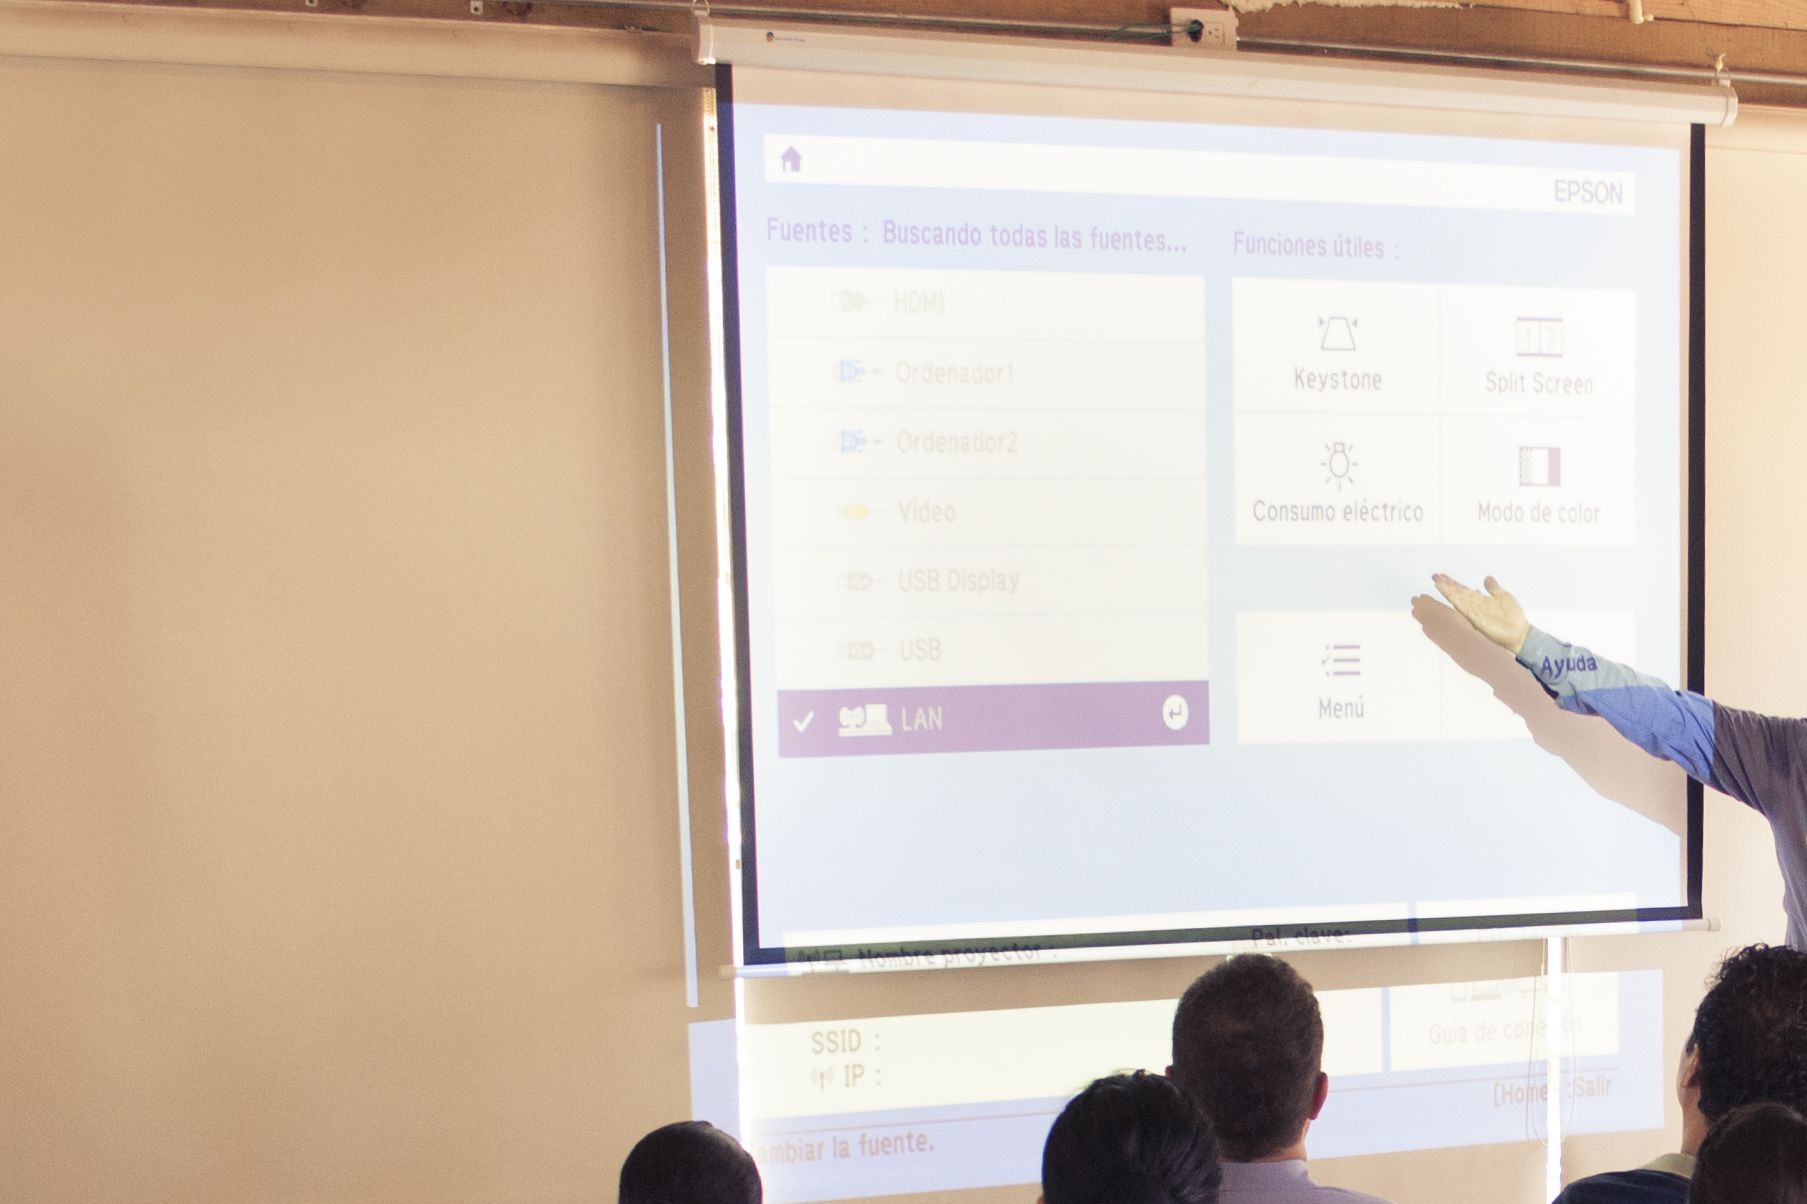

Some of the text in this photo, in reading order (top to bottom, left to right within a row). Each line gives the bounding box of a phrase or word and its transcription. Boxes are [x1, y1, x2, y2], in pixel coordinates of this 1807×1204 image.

[1554, 178, 1624, 205] EPSON
[767, 216, 853, 244] Fuentes
[883, 219, 982, 248] Buscando
[990, 223, 1048, 249] todas
[1054, 224, 1083, 250] las
[1090, 226, 1188, 254] fuentes...
[1233, 231, 1328, 257] Funciones
[1333, 232, 1385, 259] útiles
[894, 289, 945, 316] HDMI
[895, 360, 1015, 386] Ordenador1
[1294, 367, 1382, 393] Keystone
[1486, 370, 1594, 396] Split Screen
[896, 429, 1019, 455] Ordenador2
[1253, 497, 1424, 523] Consumo eléctrico
[1478, 500, 1601, 525] Modo de color
[897, 568, 1020, 595] USB Display
[899, 637, 942, 662] USB
[1541, 655, 1598, 679] Ayuda
[901, 705, 943, 732] LAN
[1318, 695, 1365, 720] Menú
[943, 942, 1042, 968] proyector
[811, 1028, 862, 1055] SSID
[1474, 1018, 1497, 1043] de
[844, 1063, 865, 1088] IP
[833, 1136, 850, 1160] la
[859, 1130, 935, 1158] fuente.
